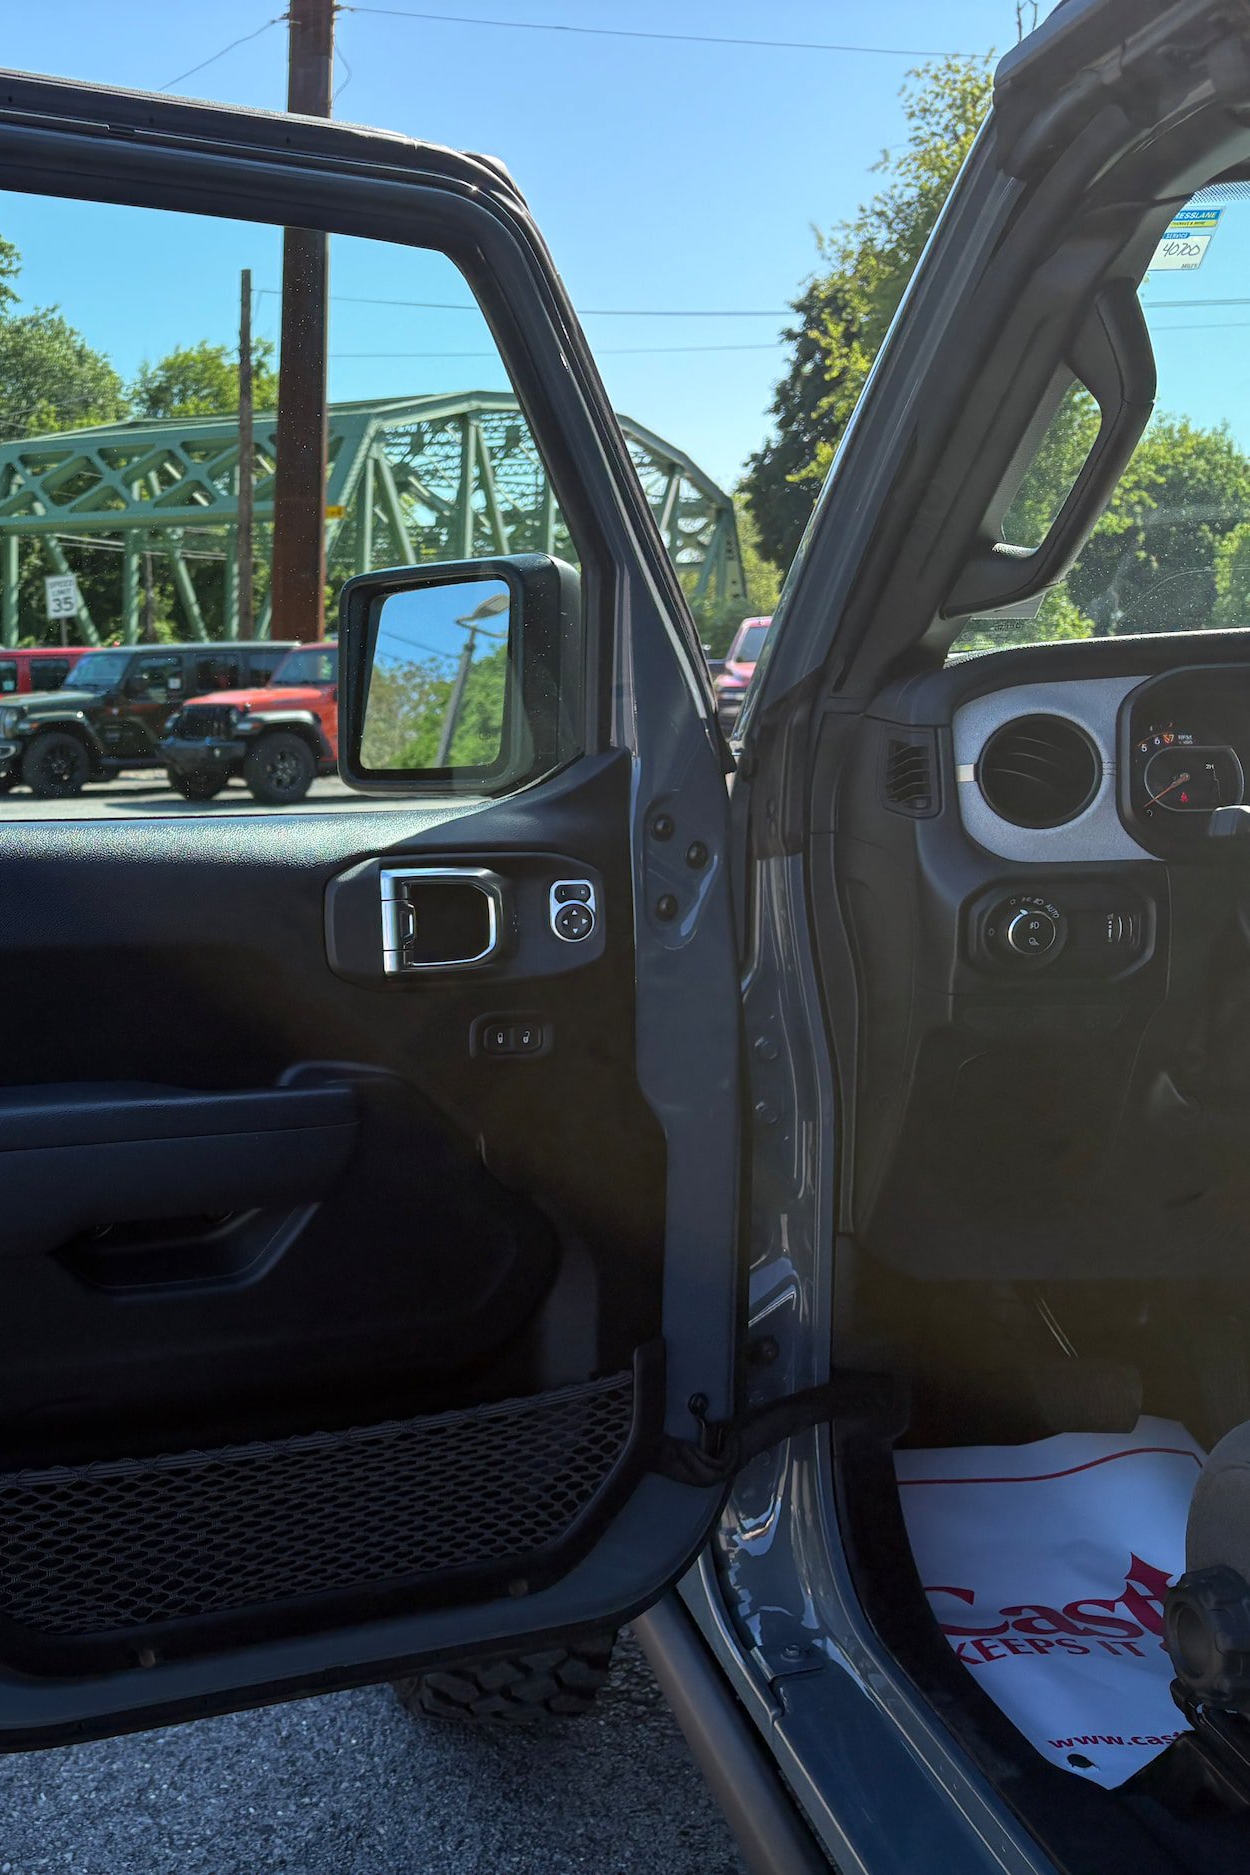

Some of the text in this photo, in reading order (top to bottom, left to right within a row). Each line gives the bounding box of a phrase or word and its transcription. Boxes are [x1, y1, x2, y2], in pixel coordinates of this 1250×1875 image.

[52, 597, 74, 613] 35
[1141, 743, 1147, 752] 5
[1045, 904, 1059, 918] AUTO
[956, 1637, 1091, 1666] KEEPS
[1097, 1639, 1146, 1658] IT
[1046, 1730, 1182, 1749] www.cas
